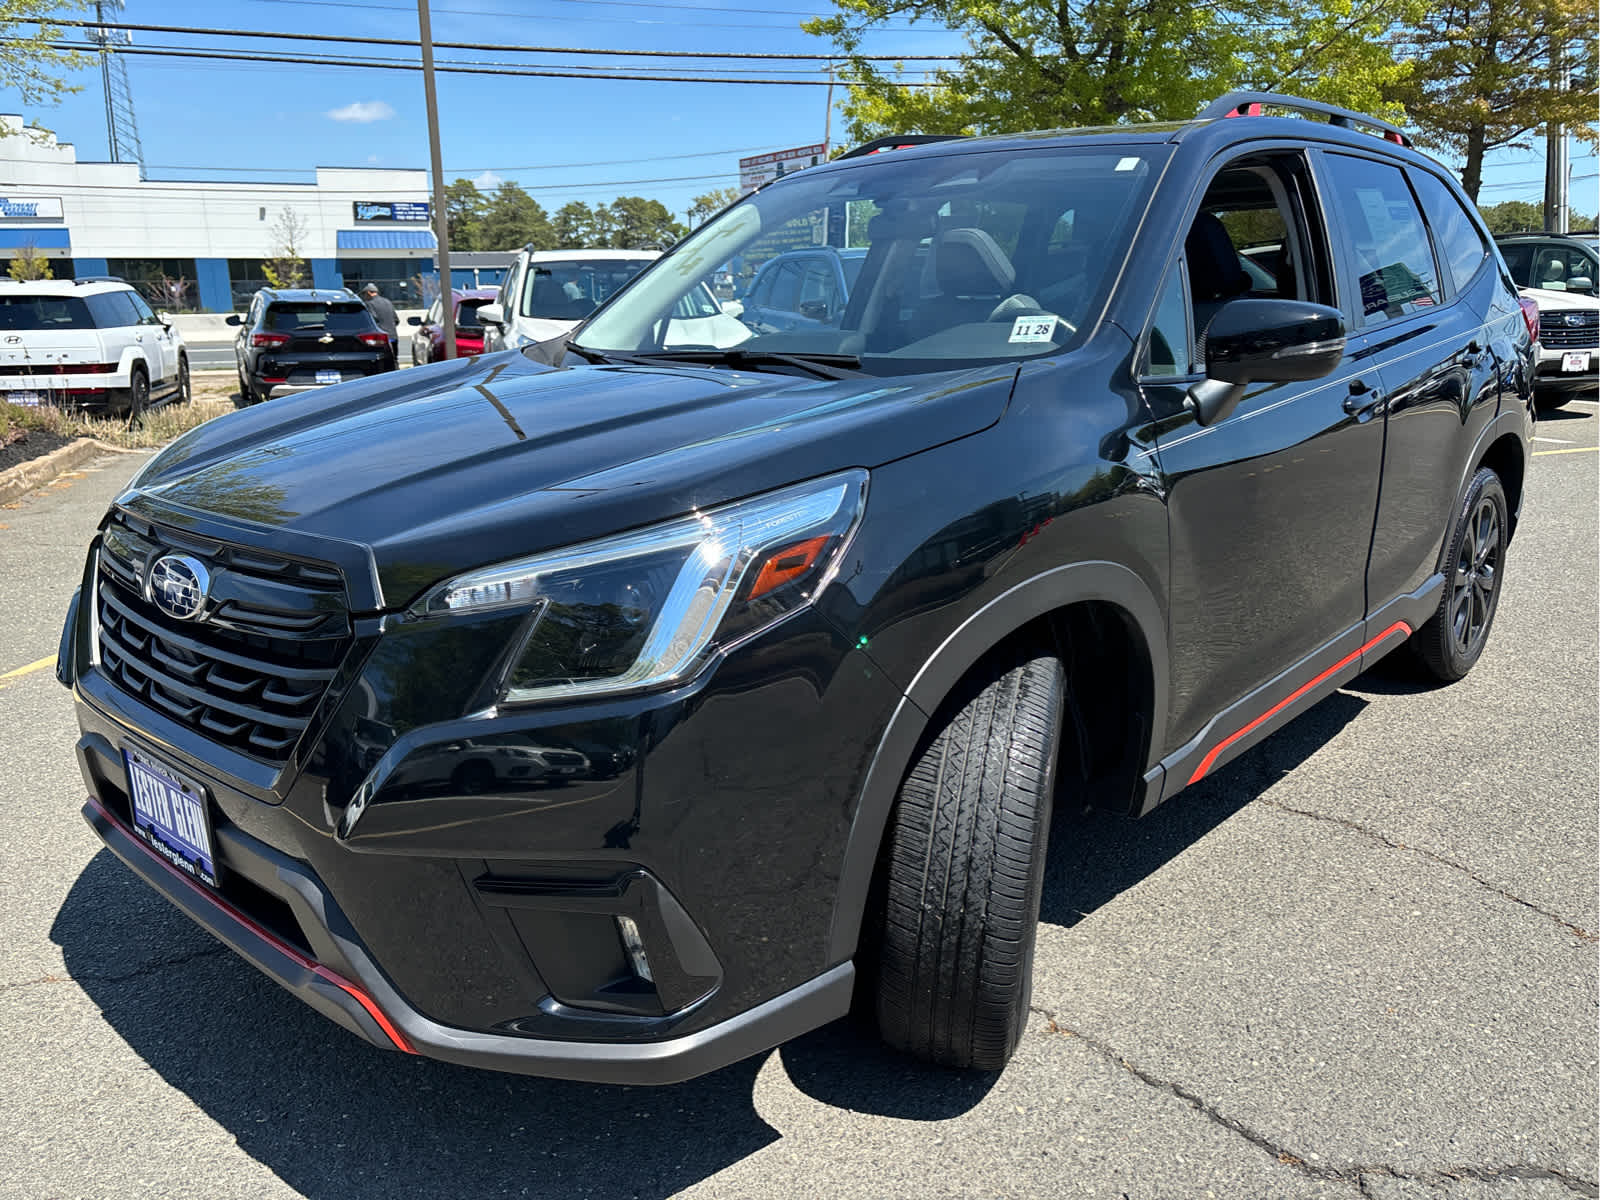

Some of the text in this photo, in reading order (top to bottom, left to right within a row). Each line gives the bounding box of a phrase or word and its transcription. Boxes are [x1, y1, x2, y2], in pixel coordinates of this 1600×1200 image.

[1016, 324, 1051, 335] 11 28
[128, 763, 173, 831] LESTER
[169, 788, 212, 858] GLENN
[150, 834, 196, 875] lesterglenn
